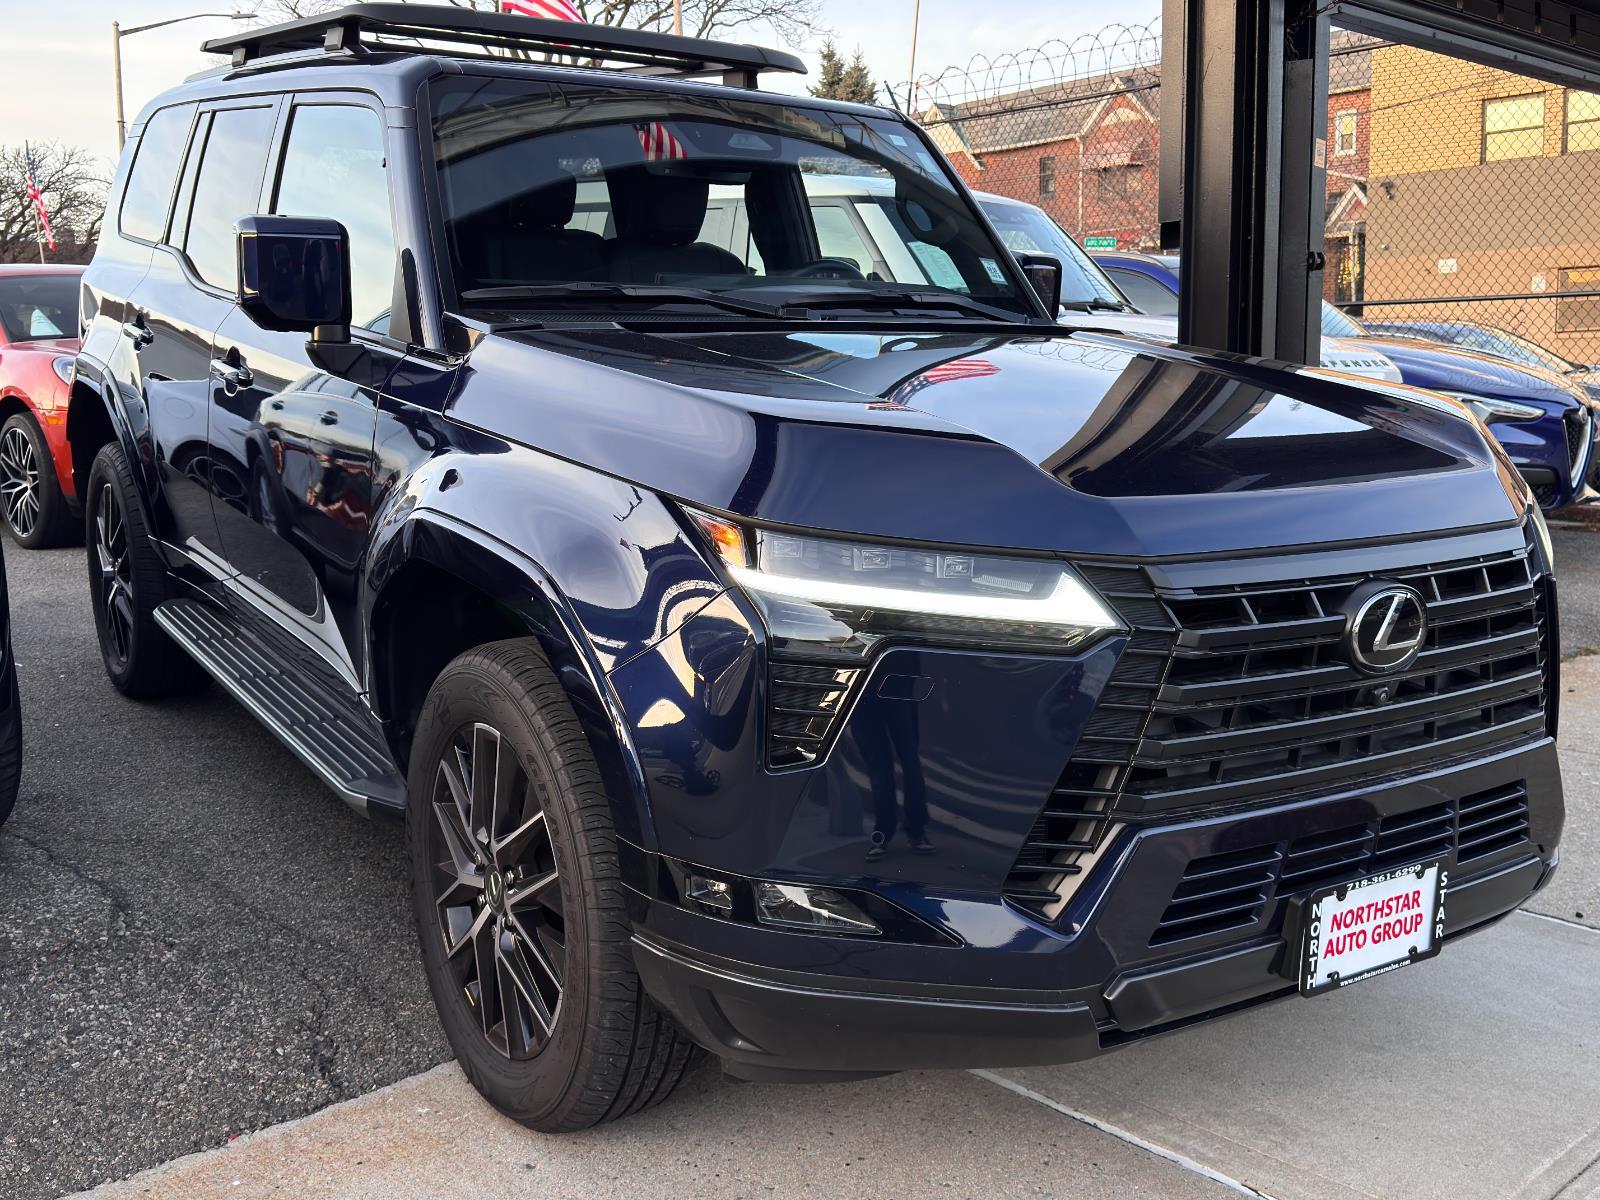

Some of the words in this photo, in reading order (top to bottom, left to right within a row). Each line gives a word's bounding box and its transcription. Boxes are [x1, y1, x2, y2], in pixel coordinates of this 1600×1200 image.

[1347, 864, 1421, 891] 718-361-6299
[1330, 889, 1421, 933] NORTHSTAR
[1323, 929, 1367, 960] AUTO
[1371, 913, 1424, 945] GROUP
